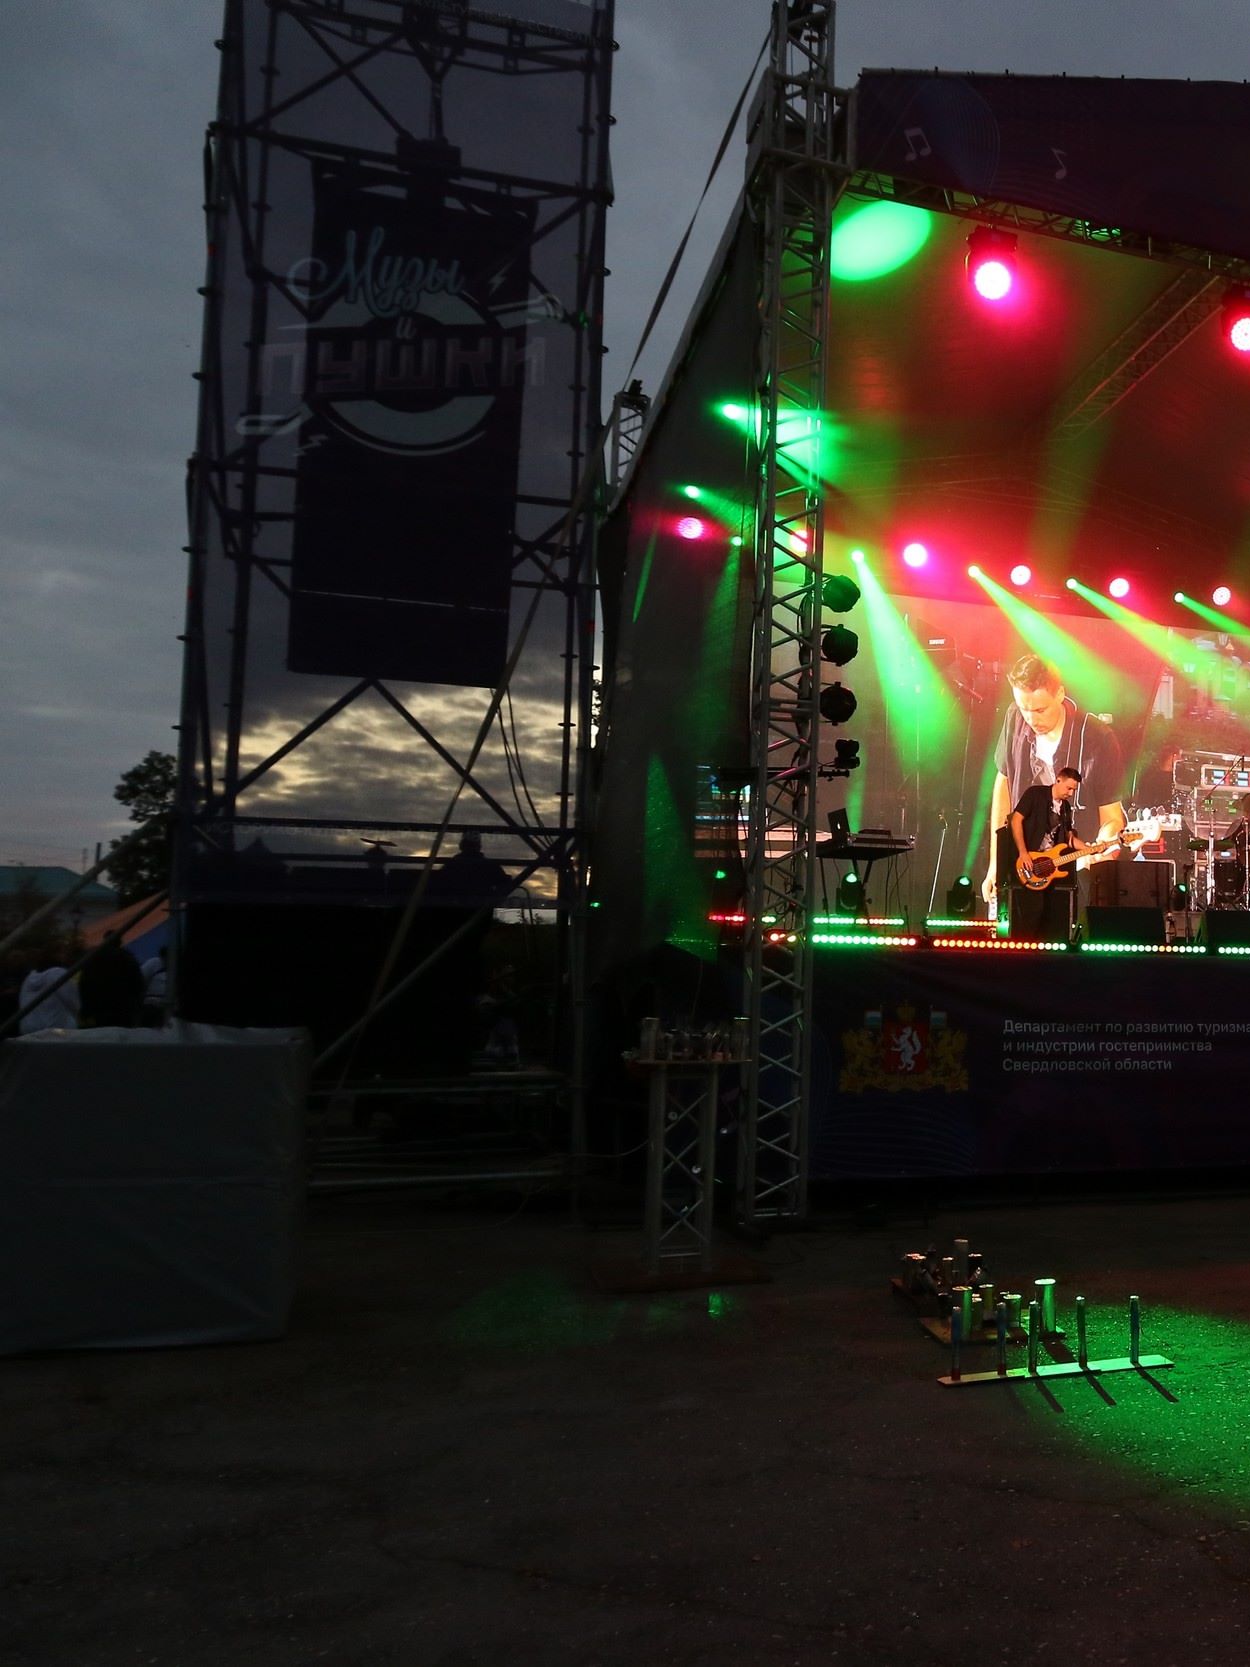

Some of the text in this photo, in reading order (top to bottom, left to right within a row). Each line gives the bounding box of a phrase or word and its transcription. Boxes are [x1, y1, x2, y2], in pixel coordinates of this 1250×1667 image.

[286, 225, 466, 319] Музы
[257, 335, 547, 397] ПУШКИ
[1002, 1018, 1101, 1035] Департамент
[1105, 1022, 1122, 1033] по
[1126, 1022, 1194, 1036] развитию
[1003, 1041, 1213, 1055] и индустрии гостеприимства
[1002, 1057, 1173, 1073] Свердловской области
